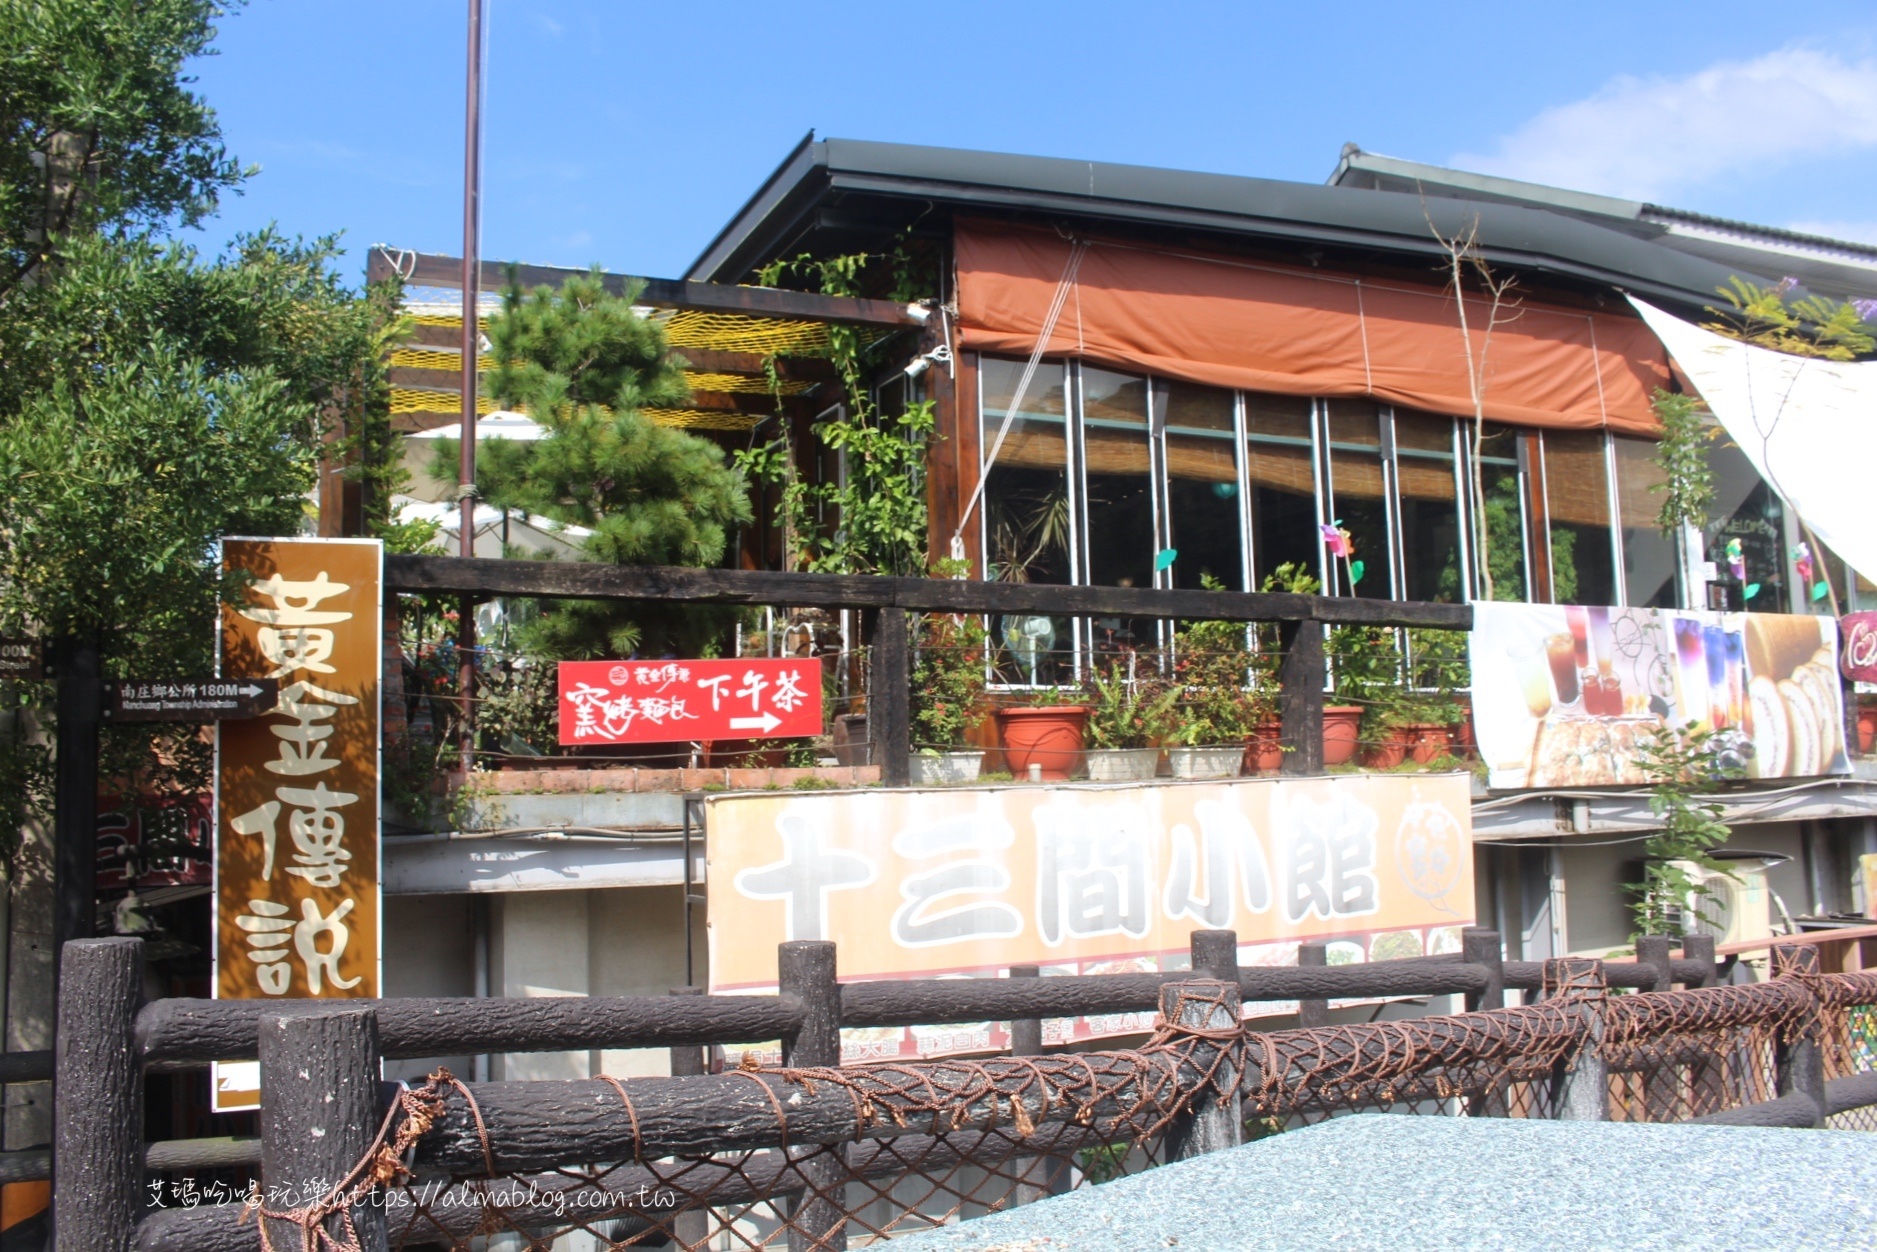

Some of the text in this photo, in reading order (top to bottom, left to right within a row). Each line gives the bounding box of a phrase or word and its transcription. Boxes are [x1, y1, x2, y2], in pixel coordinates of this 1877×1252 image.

[121, 683, 238, 700] 南庄鄉公所 180M
[697, 669, 808, 713] 下午茶
[734, 806, 1381, 949] 十三間小館
[917, 1031, 990, 1053] 蒜泥白肉
